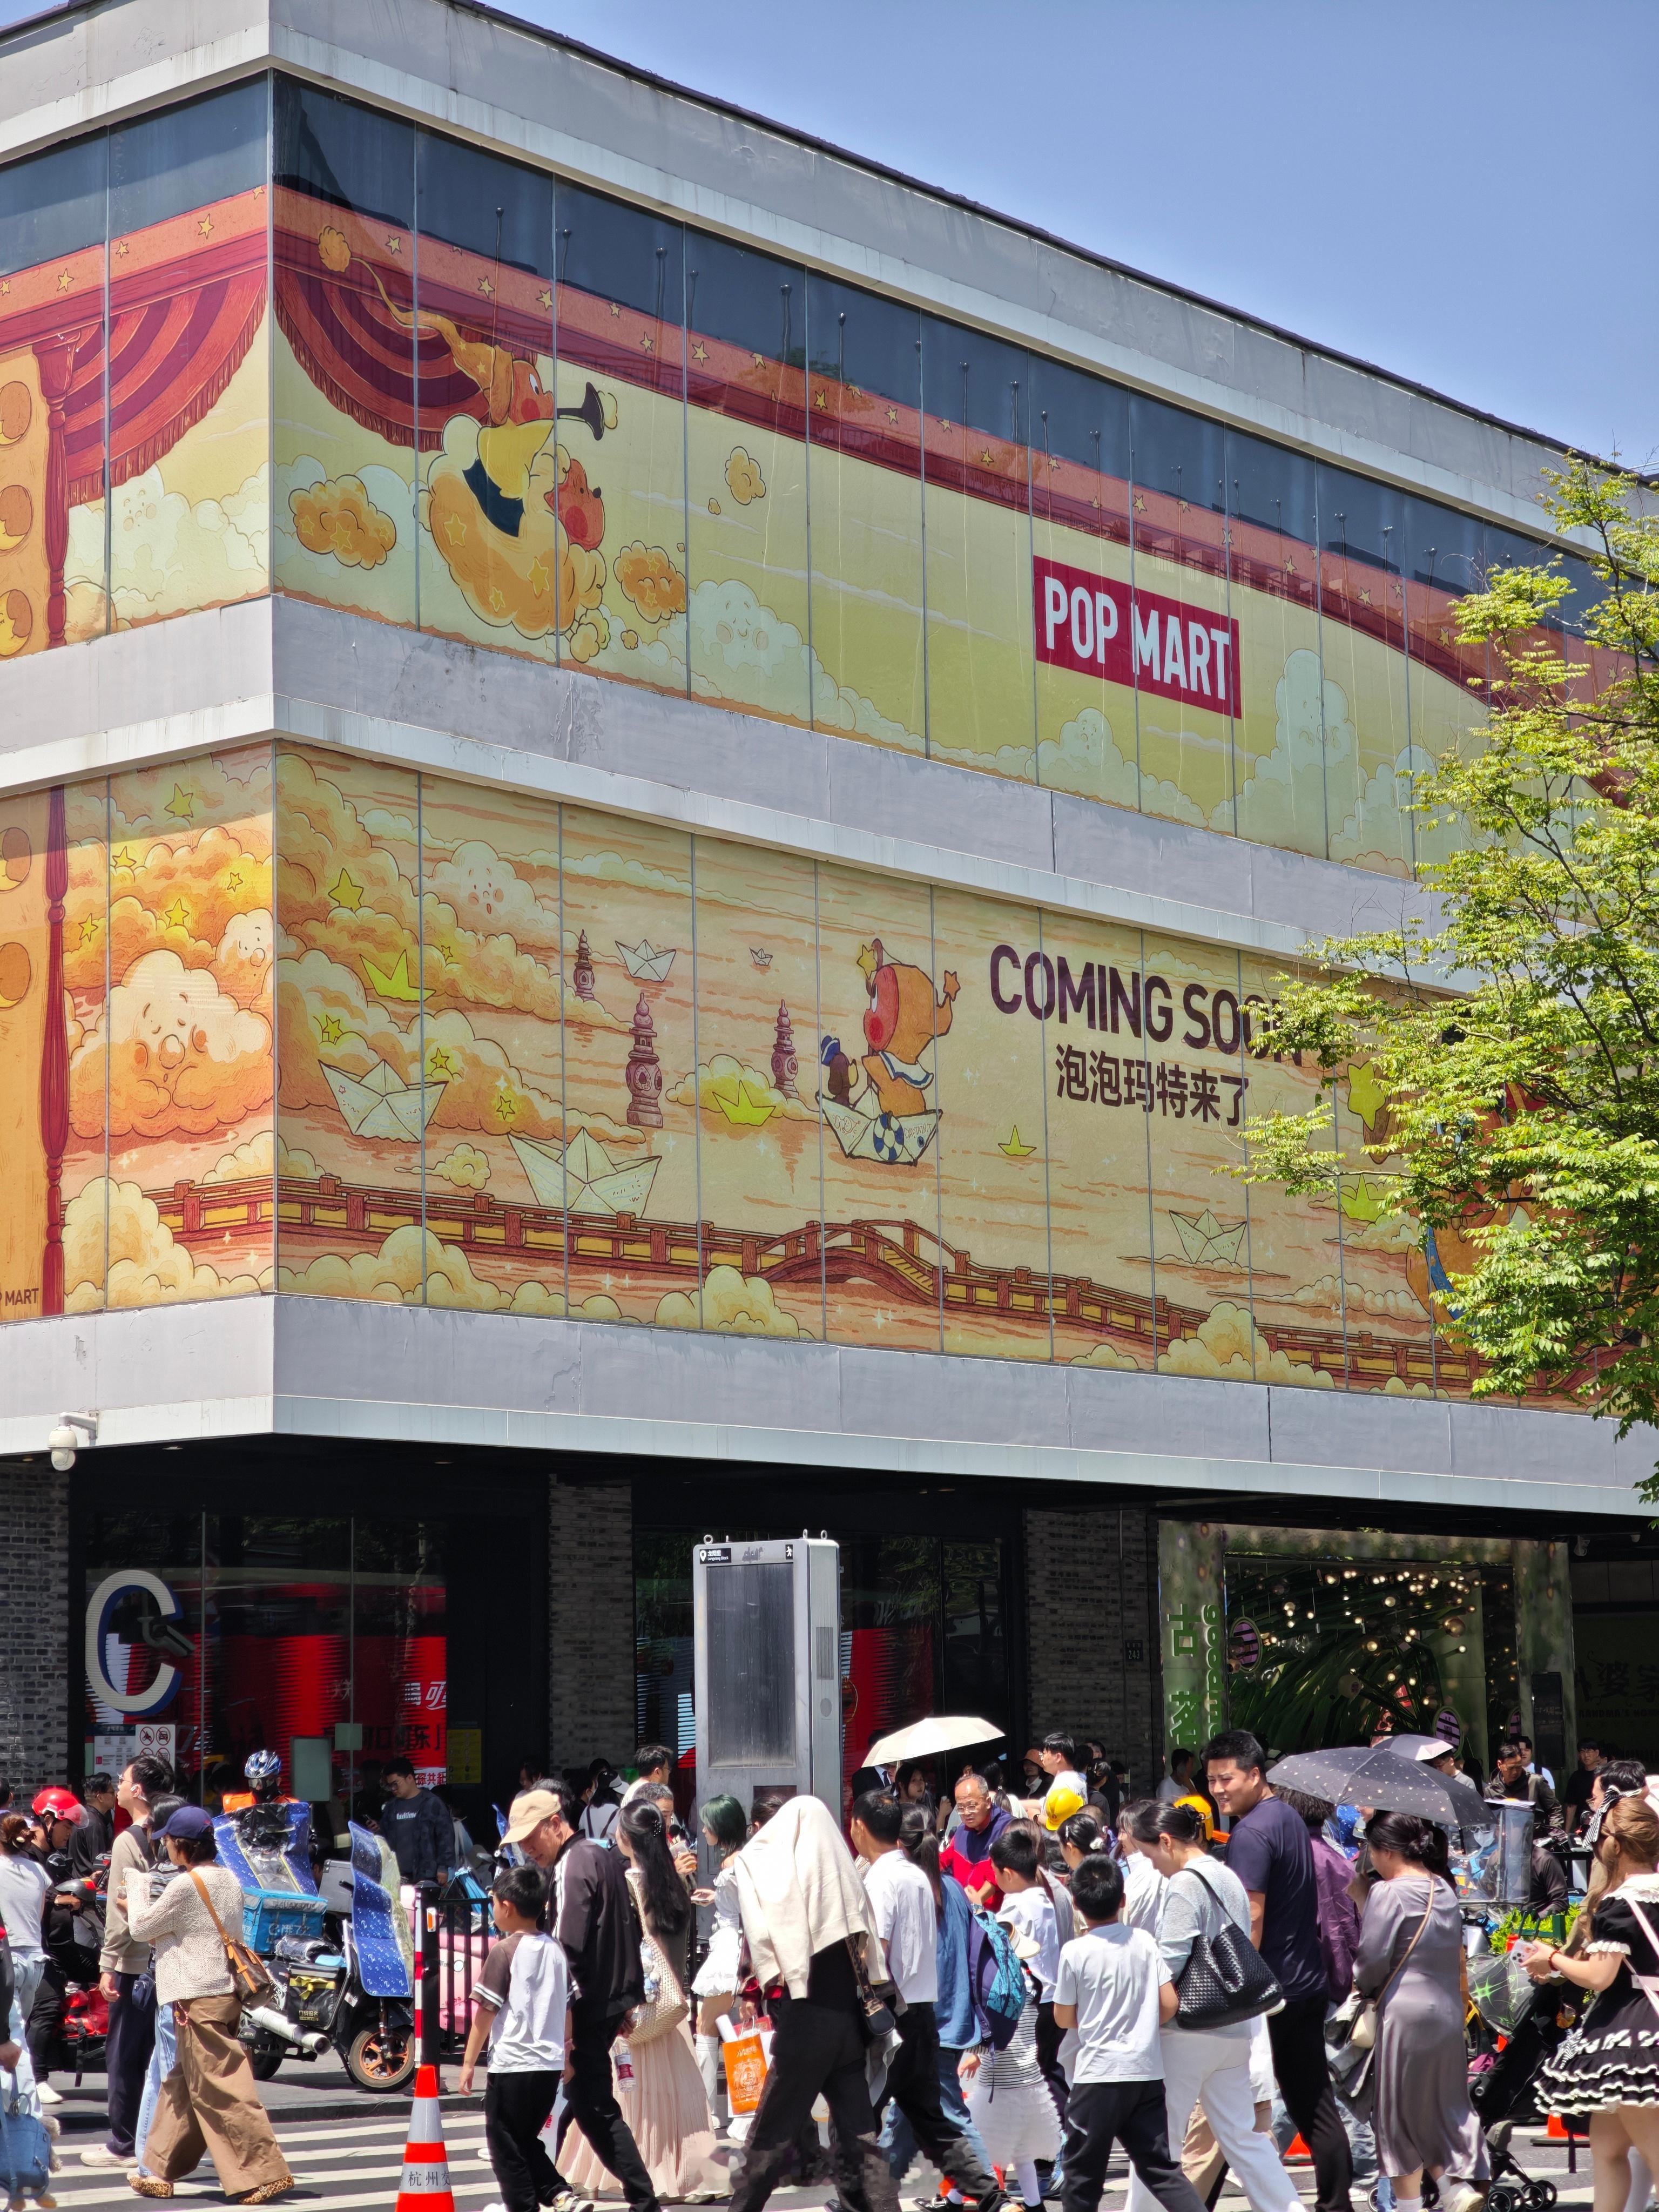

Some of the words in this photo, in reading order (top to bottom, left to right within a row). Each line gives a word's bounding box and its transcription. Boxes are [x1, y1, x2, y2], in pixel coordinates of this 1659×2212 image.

[1044, 576, 1118, 664] POP
[1131, 602, 1230, 700] MART
[990, 944, 1173, 1043] COMING
[1055, 1043, 1249, 1126] 泡泡玛特来了
[5, 1287, 39, 1306] MART
[1128, 1650, 1140, 1660] 243
